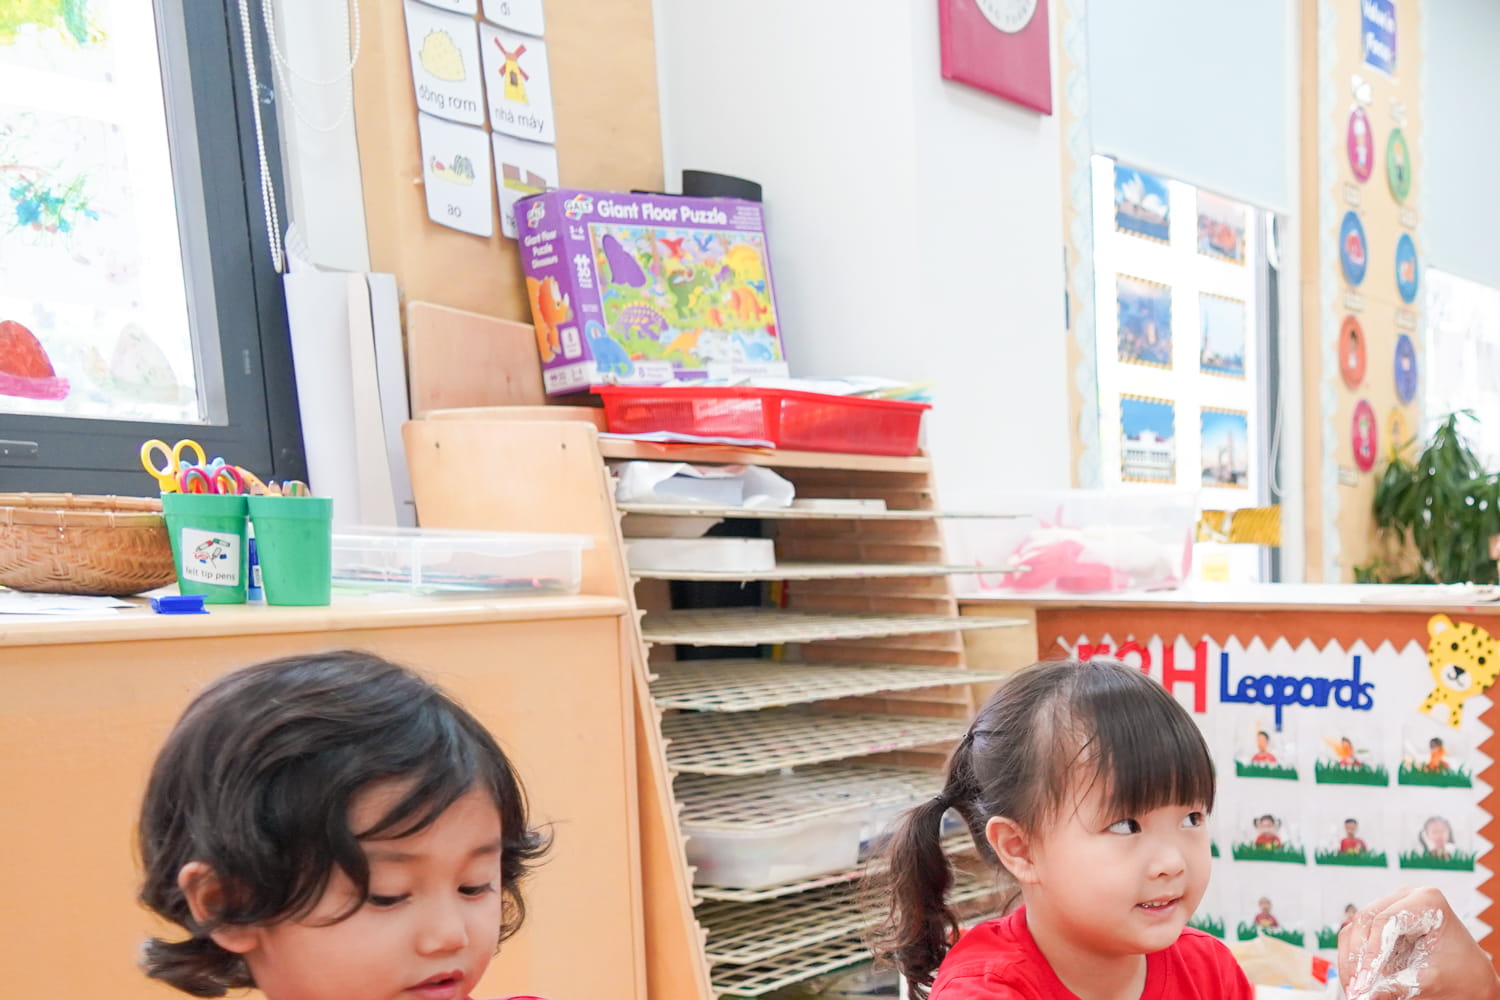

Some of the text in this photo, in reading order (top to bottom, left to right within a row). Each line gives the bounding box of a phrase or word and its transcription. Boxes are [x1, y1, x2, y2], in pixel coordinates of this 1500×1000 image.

[517, 113, 544, 133] máy
[597, 199, 639, 219] Giant
[642, 202, 678, 221] Floor
[680, 206, 728, 225] Puzzle
[215, 571, 236, 581] pens
[1219, 651, 1375, 732] Leopards
